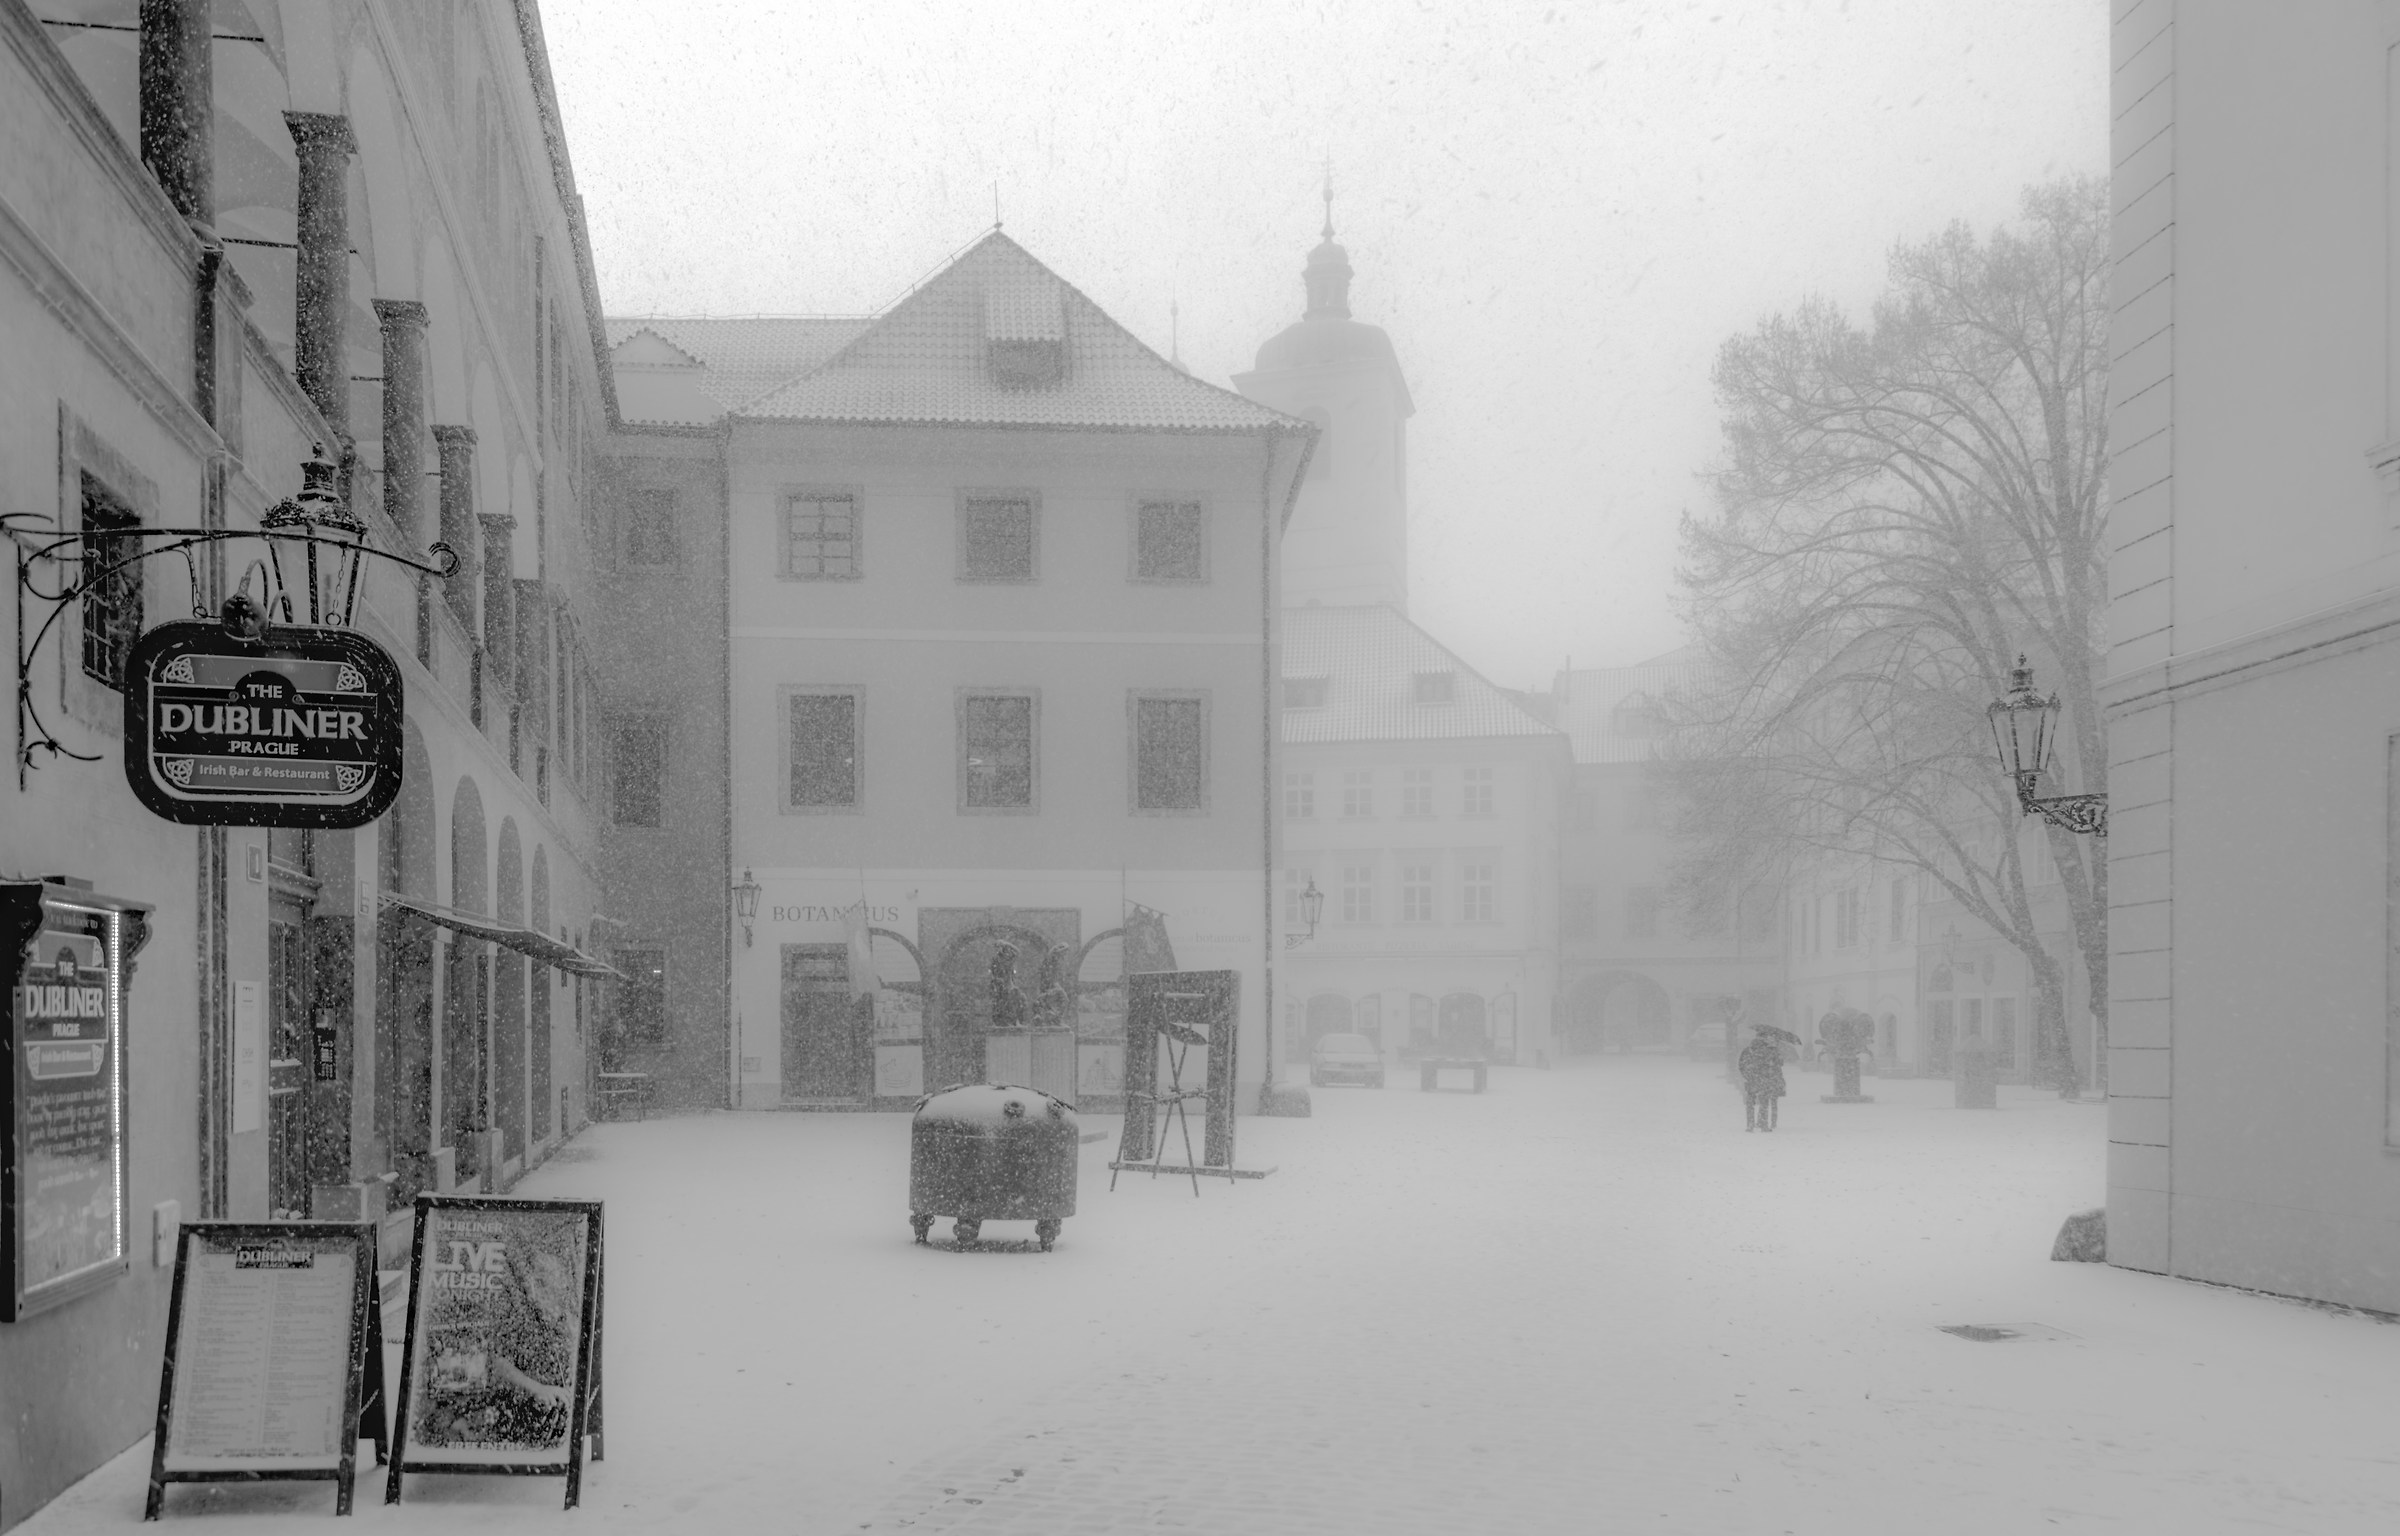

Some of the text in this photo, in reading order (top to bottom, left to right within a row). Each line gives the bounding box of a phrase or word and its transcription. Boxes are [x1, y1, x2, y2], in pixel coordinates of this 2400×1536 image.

[246, 683, 283, 699] THE
[160, 703, 368, 740] DUBLINER
[230, 740, 299, 756] PRAGUE
[199, 764, 330, 780] Irish Bar & Restaurant
[772, 906, 899, 922] BOTANUS
[58, 961, 74, 977] THE
[25, 985, 105, 1018] DUBLINER
[52, 1023, 80, 1037] PRAGUE
[437, 1220, 503, 1233] DUBLINER
[239, 1250, 312, 1263] DUBLINER
[429, 1241, 506, 1271] LIVE
[428, 1272, 503, 1289] MUSIC
[431, 1289, 501, 1301] ONIGHT
